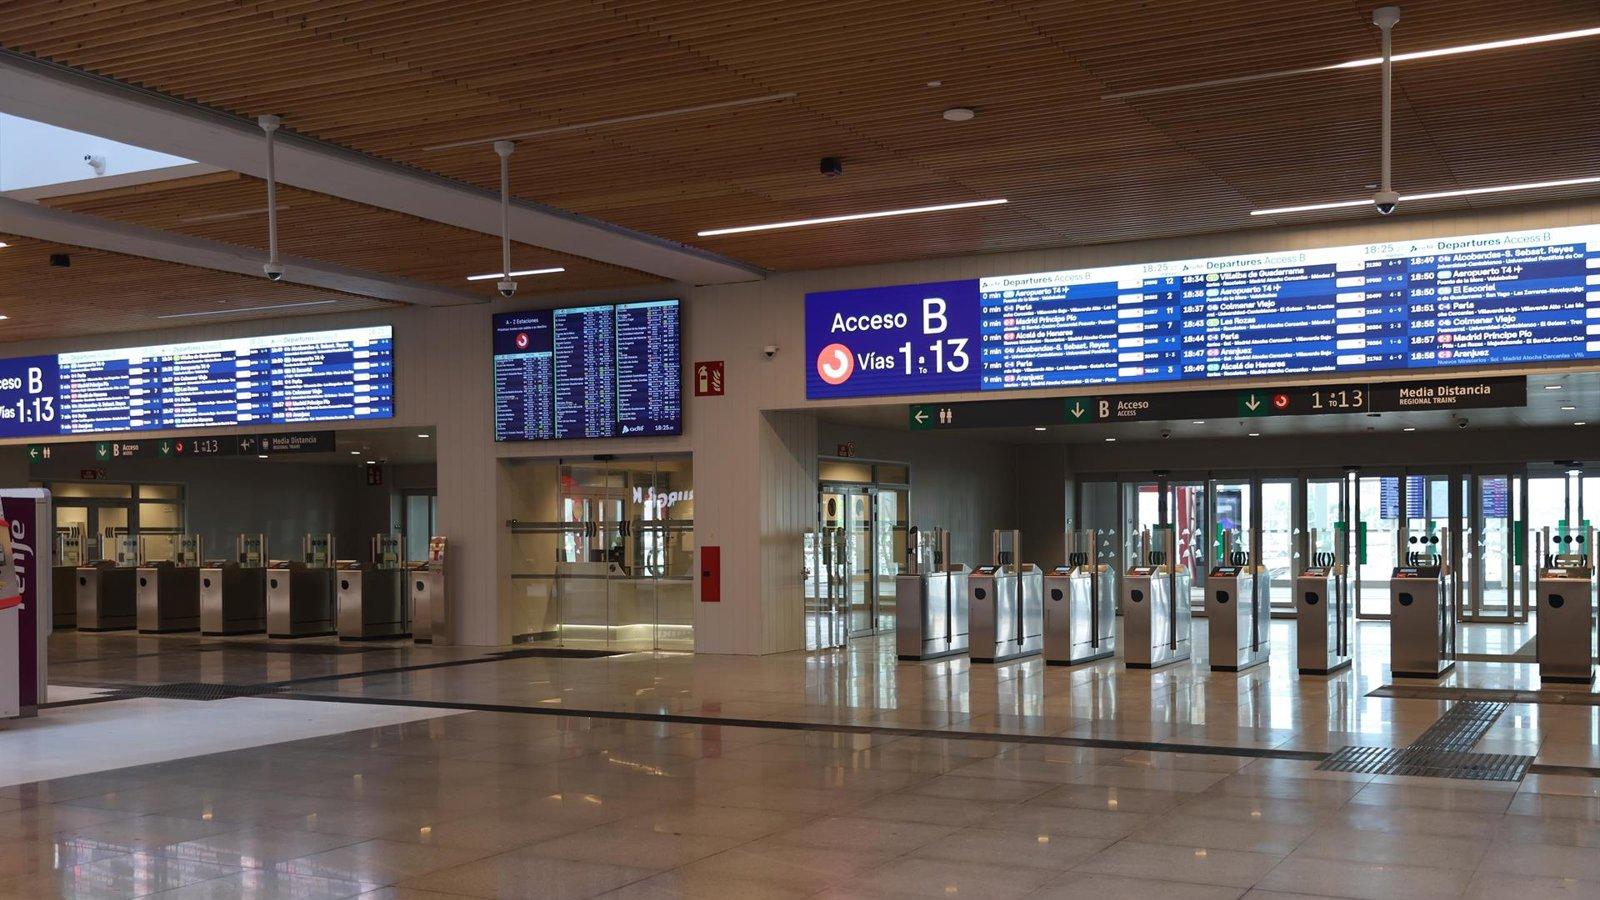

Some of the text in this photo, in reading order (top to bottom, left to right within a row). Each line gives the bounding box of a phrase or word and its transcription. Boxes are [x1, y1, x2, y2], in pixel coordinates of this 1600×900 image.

[1437, 231, 1551, 251] Departures Access B
[1364, 245, 1394, 255] 18:25
[1548, 246, 1574, 256] Reyes
[1206, 259, 1262, 271] Departures
[1453, 268, 1500, 279] Aeropuerto
[1500, 265, 1513, 274] T4
[1003, 277, 1054, 288] Departures
[1462, 283, 1496, 293] Escorial
[830, 297, 949, 335] Acceso B
[1015, 317, 1038, 325] Madrid
[1453, 317, 1494, 326] Colmenar
[1494, 314, 1516, 324] Viejo
[1453, 332, 1483, 342] Madrid
[1519, 329, 1533, 338] Pío
[857, 337, 970, 375] Vías 1 a To 13
[1453, 349, 1490, 359] Aranjuez
[989, 362, 1002, 370] min
[0, 367, 43, 394] eso B
[1399, 384, 1491, 398] Media Distancia
[1311, 391, 1323, 409] 1
[1338, 388, 1363, 407] 13
[1399, 396, 1457, 406] REGIONAL TRAINS
[16, 398, 25, 423] 1
[33, 396, 54, 422] 13
[1099, 398, 1149, 418] B Acceso
[193, 439, 219, 453] 1 13
[272, 435, 317, 446] Media Distancia
[113, 443, 140, 457] B Acceso
